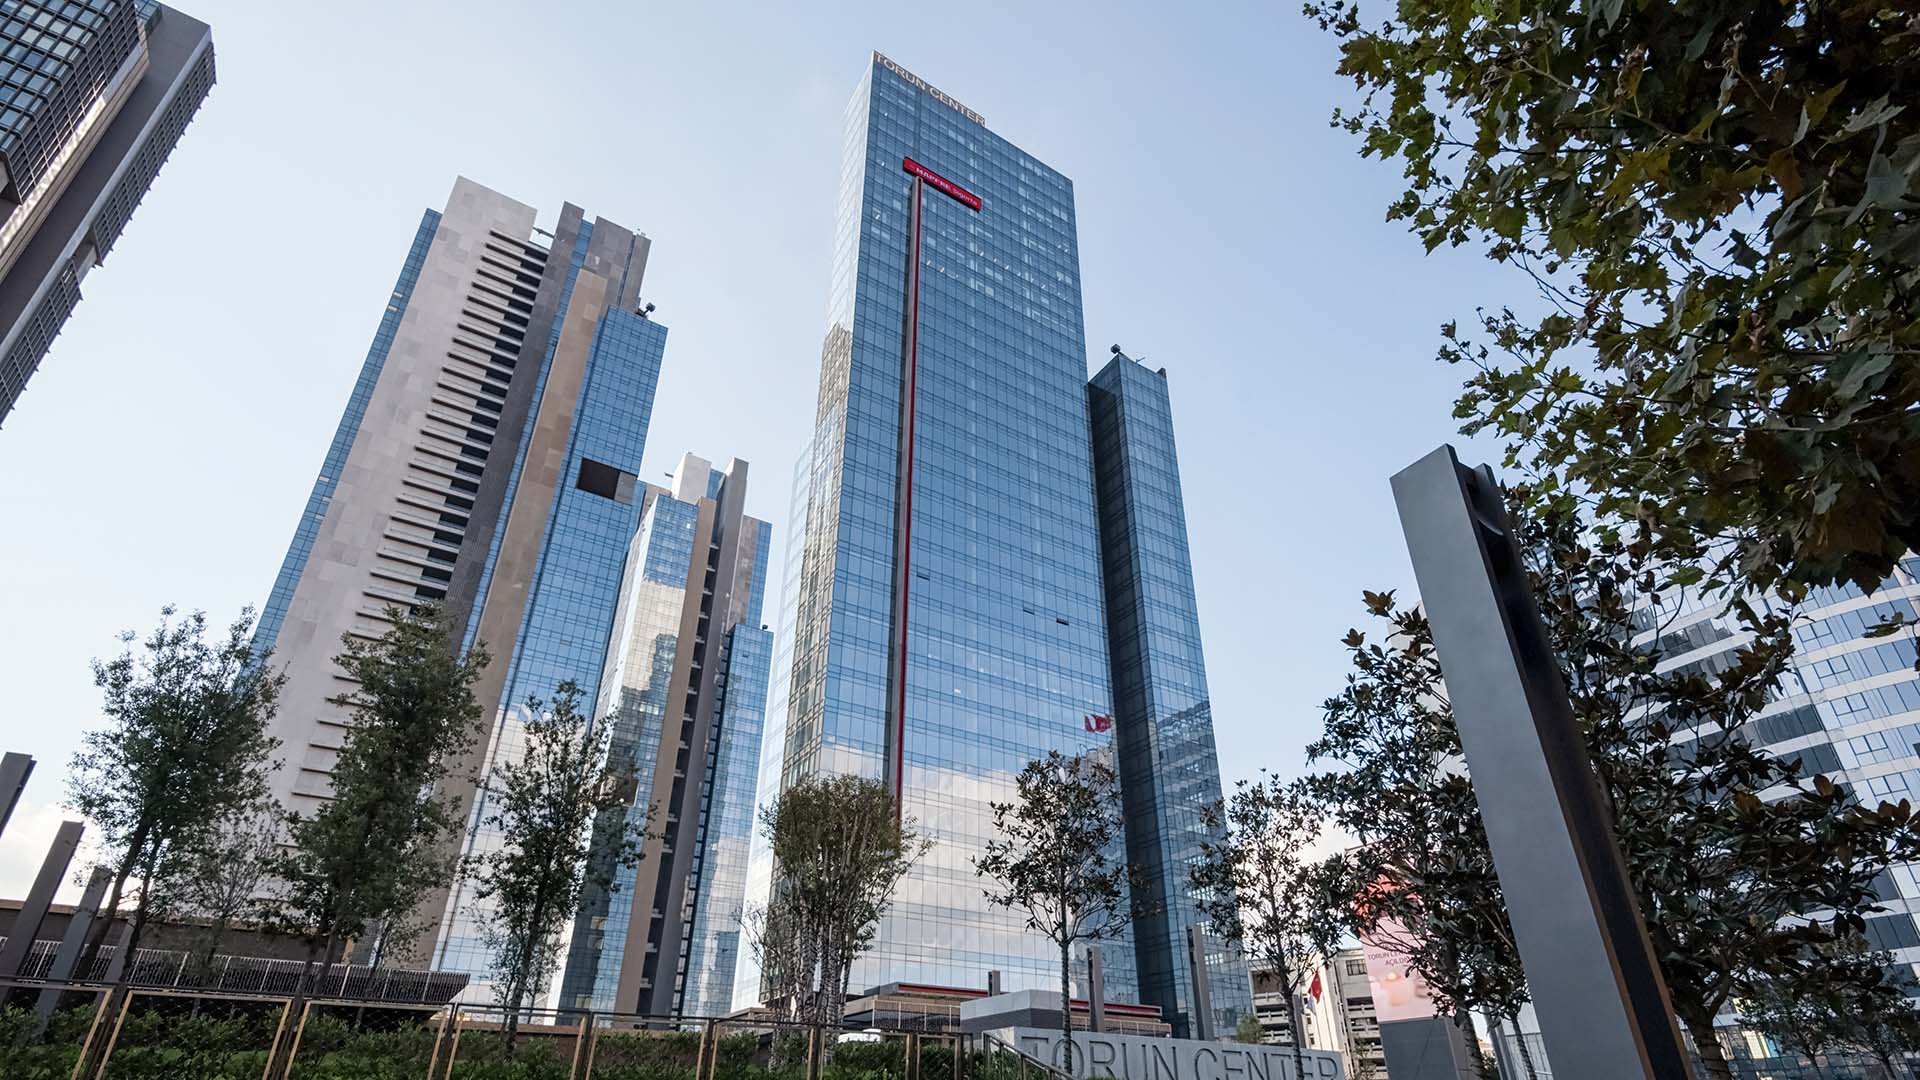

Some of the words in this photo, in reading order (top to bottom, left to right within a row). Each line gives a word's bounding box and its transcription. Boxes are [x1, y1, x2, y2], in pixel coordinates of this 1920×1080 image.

[875, 52, 926, 91] TORUN
[930, 87, 985, 127] CENTER
[1021, 1036, 1178, 1080] TORUN
